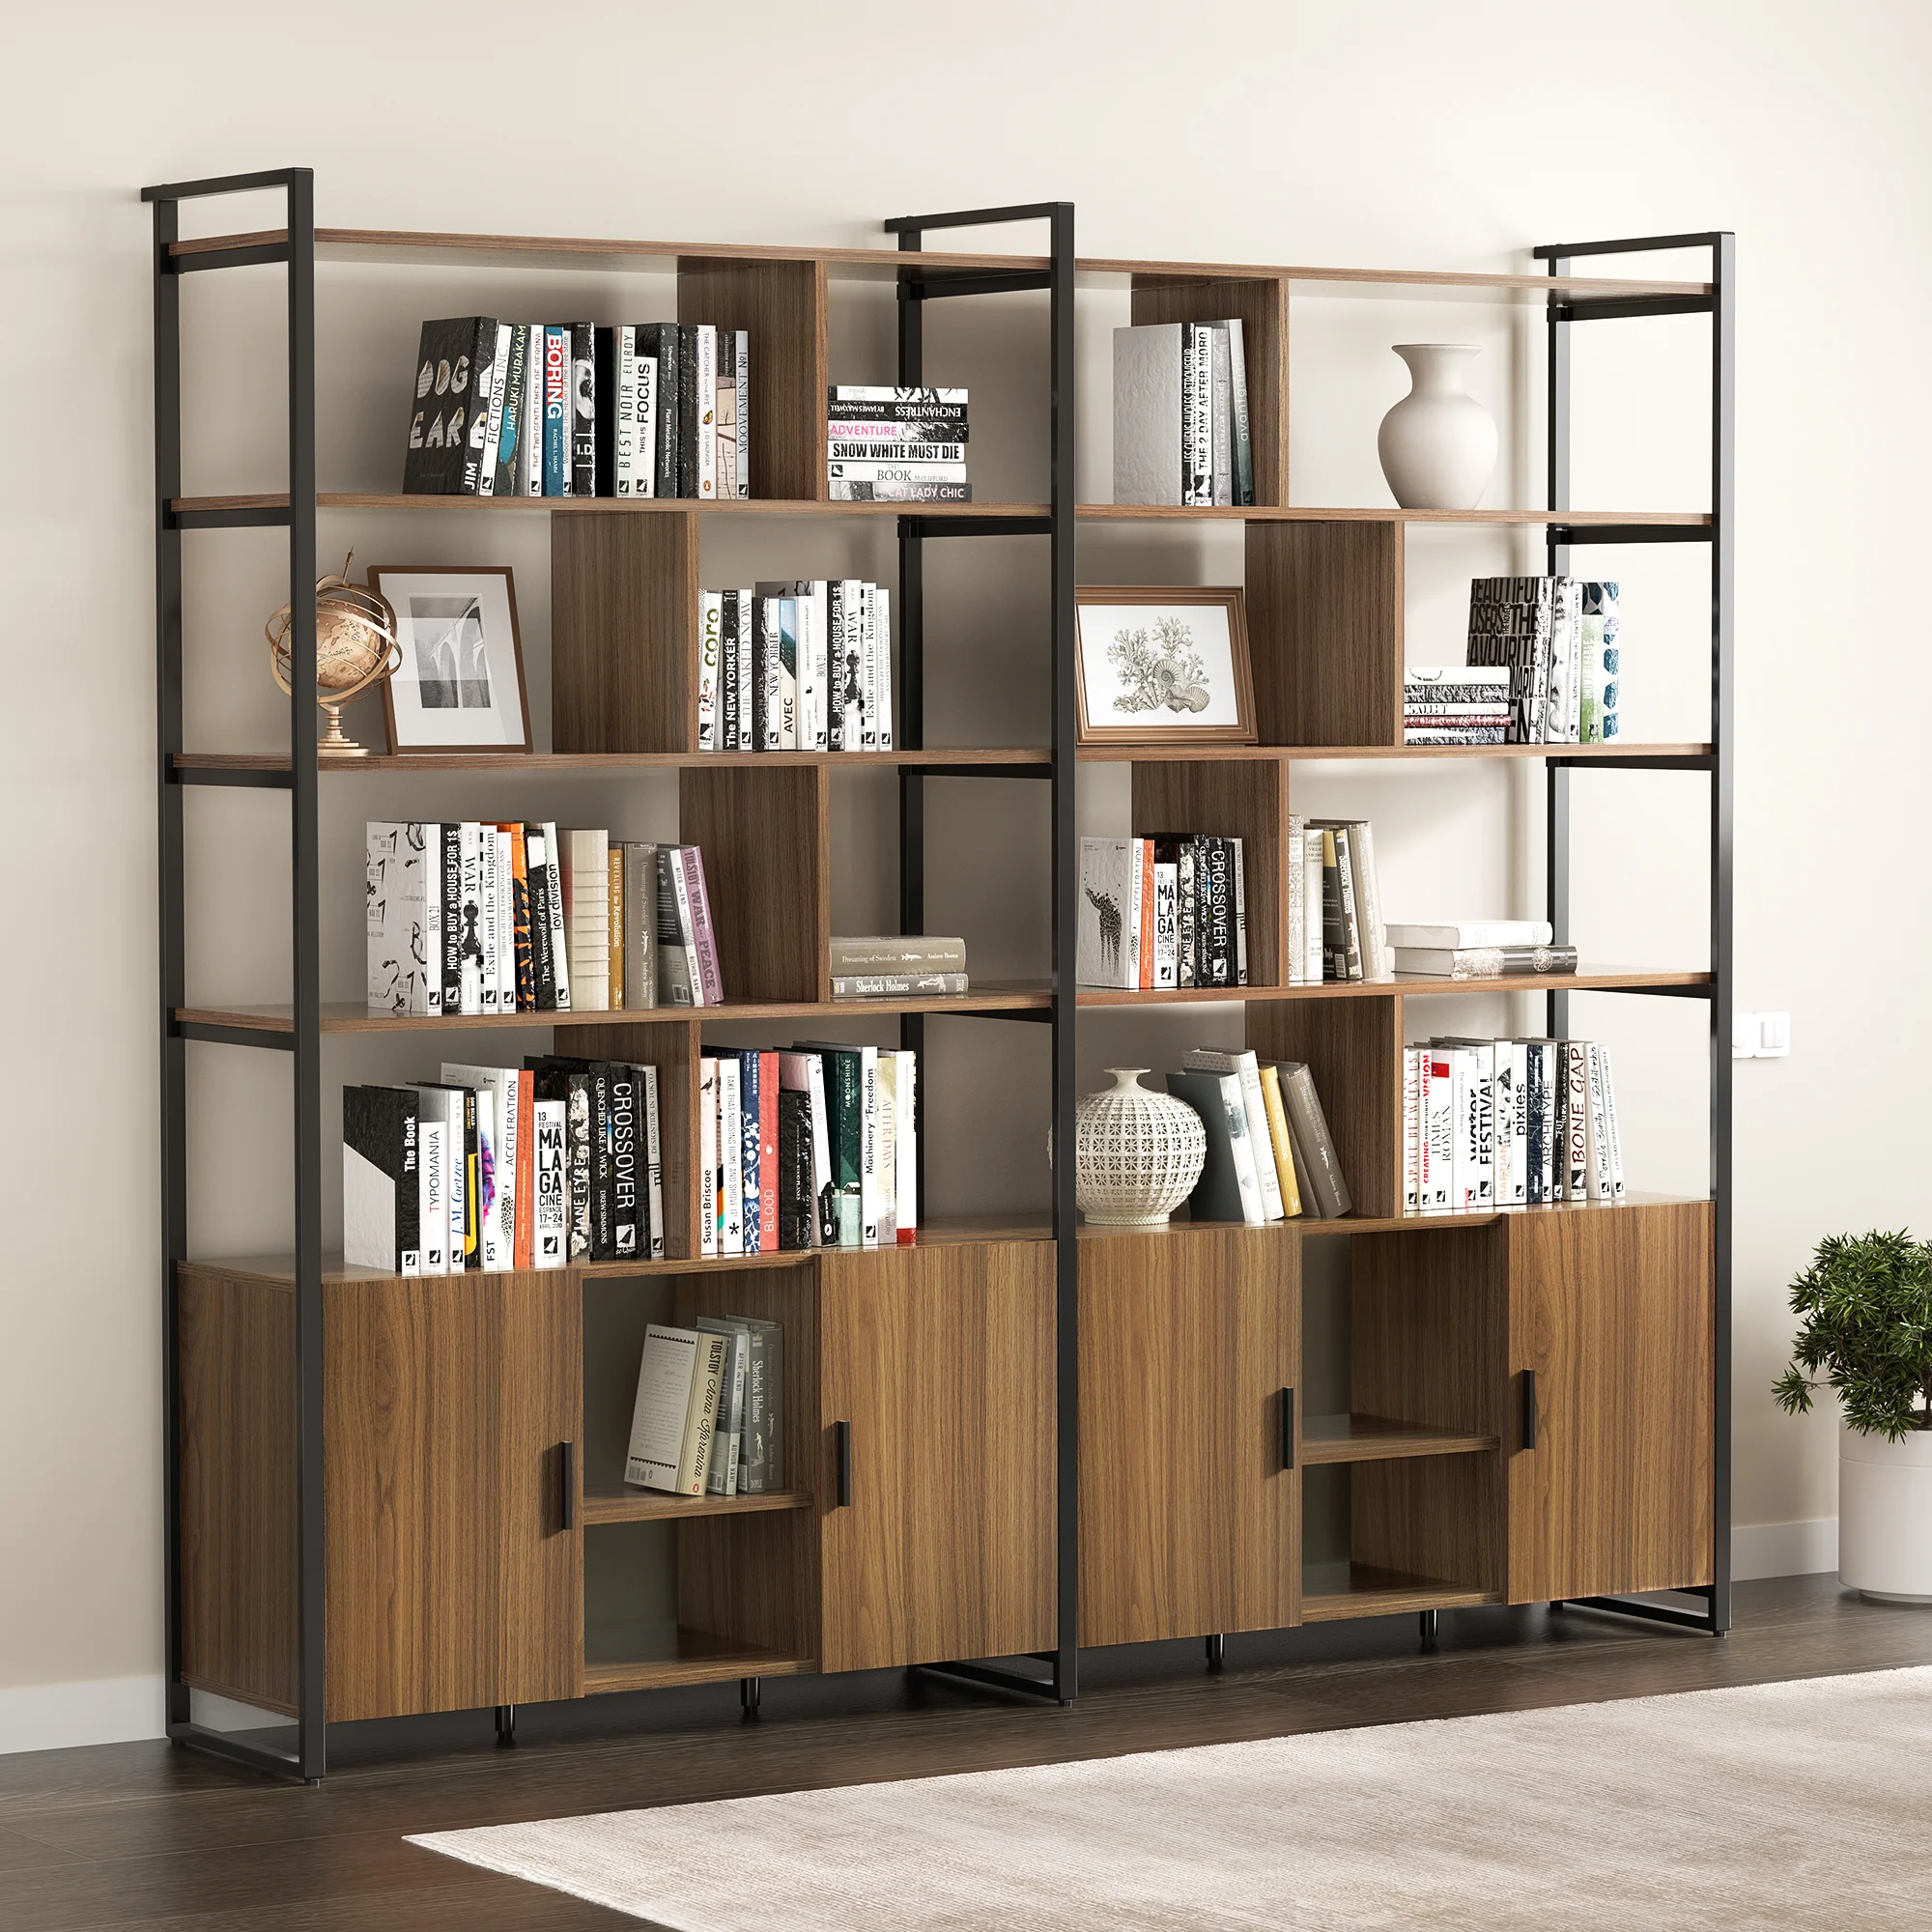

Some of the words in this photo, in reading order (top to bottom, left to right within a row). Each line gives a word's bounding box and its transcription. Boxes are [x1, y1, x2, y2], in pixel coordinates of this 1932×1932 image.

[623, 334, 634, 375] ELLROY
[417, 355, 469, 398] DOG
[547, 333, 563, 419] BORING
[1198, 371, 1208, 406] AFTER
[487, 378, 505, 444] FICTIONS
[496, 345, 510, 373] INC.
[506, 384, 521, 431] HARUKI
[620, 384, 634, 421] NOIR
[638, 363, 650, 424] FOCUS
[1233, 352, 1248, 442] avantgarde
[738, 372, 748, 454] MOOVEMENT
[895, 406, 961, 417] ENCHANTRESS
[410, 407, 465, 449] EAR
[830, 425, 897, 437] ADVENTURE
[618, 430, 632, 469] BEST
[833, 442, 867, 458] SNOW
[869, 444, 905, 458] WHITE
[908, 444, 939, 460] MUST
[942, 445, 960, 460] DIE
[1198, 447, 1208, 470] THE
[464, 462, 478, 490] JIM
[877, 469, 912, 481] BOOK
[911, 487, 937, 498] LADY
[940, 487, 964, 498] CHIC
[741, 599, 751, 636] NOW
[833, 599, 842, 618] FOR
[866, 589, 876, 639] Kingdom
[833, 620, 842, 650] HOUSE
[848, 611, 858, 643] WAR
[725, 638, 736, 690] YORKER
[742, 641, 752, 692] NAKED
[769, 632, 779, 675] YORKER
[833, 660, 842, 678] BUY
[866, 643, 875, 663] the
[769, 675, 779, 696] NEW
[816, 663, 826, 677] BOX
[833, 680, 842, 690] to
[866, 665, 875, 686] and
[725, 690, 737, 721] NEW
[742, 696, 752, 719] THE
[783, 697, 794, 733] AVEC
[833, 691, 842, 713] HOW
[866, 689, 875, 719] Exile
[726, 724, 736, 748] The
[445, 831, 458, 842] 1$
[446, 845, 458, 866] FOR
[485, 832, 497, 889] Kingdom
[446, 867, 458, 901] HOUSE
[465, 856, 475, 893] WAR
[549, 864, 560, 910] division
[485, 893, 495, 913] the
[537, 888, 546, 910] Paris
[1157, 900, 1175, 918] LA
[1211, 850, 1227, 947] CROSSOVER
[429, 915, 440, 931] BOX
[446, 912, 458, 931] BUY
[485, 916, 495, 939] and
[1157, 918, 1175, 934] GA
[1182, 908, 1192, 934] EYRE
[446, 935, 458, 945] to
[538, 923, 549, 963] Werewolf
[691, 889, 705, 927] WAR
[699, 940, 717, 989] PEACE
[1157, 934, 1175, 944] CINE
[446, 947, 458, 970] HOW
[485, 944, 495, 976] Exile
[542, 964, 551, 985] The
[842, 954, 869, 964] Dreaming
[875, 953, 896, 962] Sweden
[856, 979, 884, 993] Sherlock
[886, 979, 910, 992] Holmes
[1408, 1058, 1418, 1072] US
[1571, 1047, 1584, 1094] GAP
[726, 1074, 735, 1092] TAKE
[866, 1068, 874, 1115] Freedom
[538, 1111, 547, 1121] 13
[595, 1077, 607, 1125] QUENCHED
[1408, 1079, 1418, 1138] BETWEEN
[1513, 1083, 1526, 1136] pixies
[404, 1116, 415, 1148] Book
[505, 1080, 517, 1167] ACCELERATION
[727, 1113, 736, 1144] NURSING
[1432, 1111, 1441, 1155] TIMES
[1441, 1105, 1451, 1161] ROMAN
[1480, 1072, 1492, 1165] FESTIVAL
[1543, 1080, 1552, 1167] ARCHITYPE
[1571, 1103, 1585, 1163] BONE
[598, 1126, 607, 1144] LIKE
[613, 1082, 636, 1208] CROSSOVER
[866, 1122, 875, 1175] Machinery
[404, 1150, 415, 1173] The
[539, 1150, 562, 1172] LA
[599, 1154, 608, 1179] WICK
[883, 1139, 893, 1169] DAYS
[1408, 1144, 1418, 1184] SPACE
[429, 1130, 440, 1213] TYPOMANIA
[539, 1172, 562, 1194] GA
[573, 1157, 586, 1194] EYRE
[1499, 1145, 1508, 1200] MARTIAN
[539, 1194, 562, 1207] CINE
[702, 1169, 711, 1209] Briscoe
[451, 1206, 464, 1222] M.
[539, 1213, 563, 1223] 17-24
[574, 1199, 586, 1231] JANE
[763, 1189, 775, 1233] BLOOD
[703, 1212, 712, 1244] Susan
[707, 1340, 724, 1376] TOLSTOY
[766, 1343, 775, 1375] Dreaming
[752, 1360, 763, 1393] Sherlock
[703, 1378, 717, 1414] Anna
[752, 1395, 763, 1424] Holmes
[695, 1418, 711, 1478] Karenina
